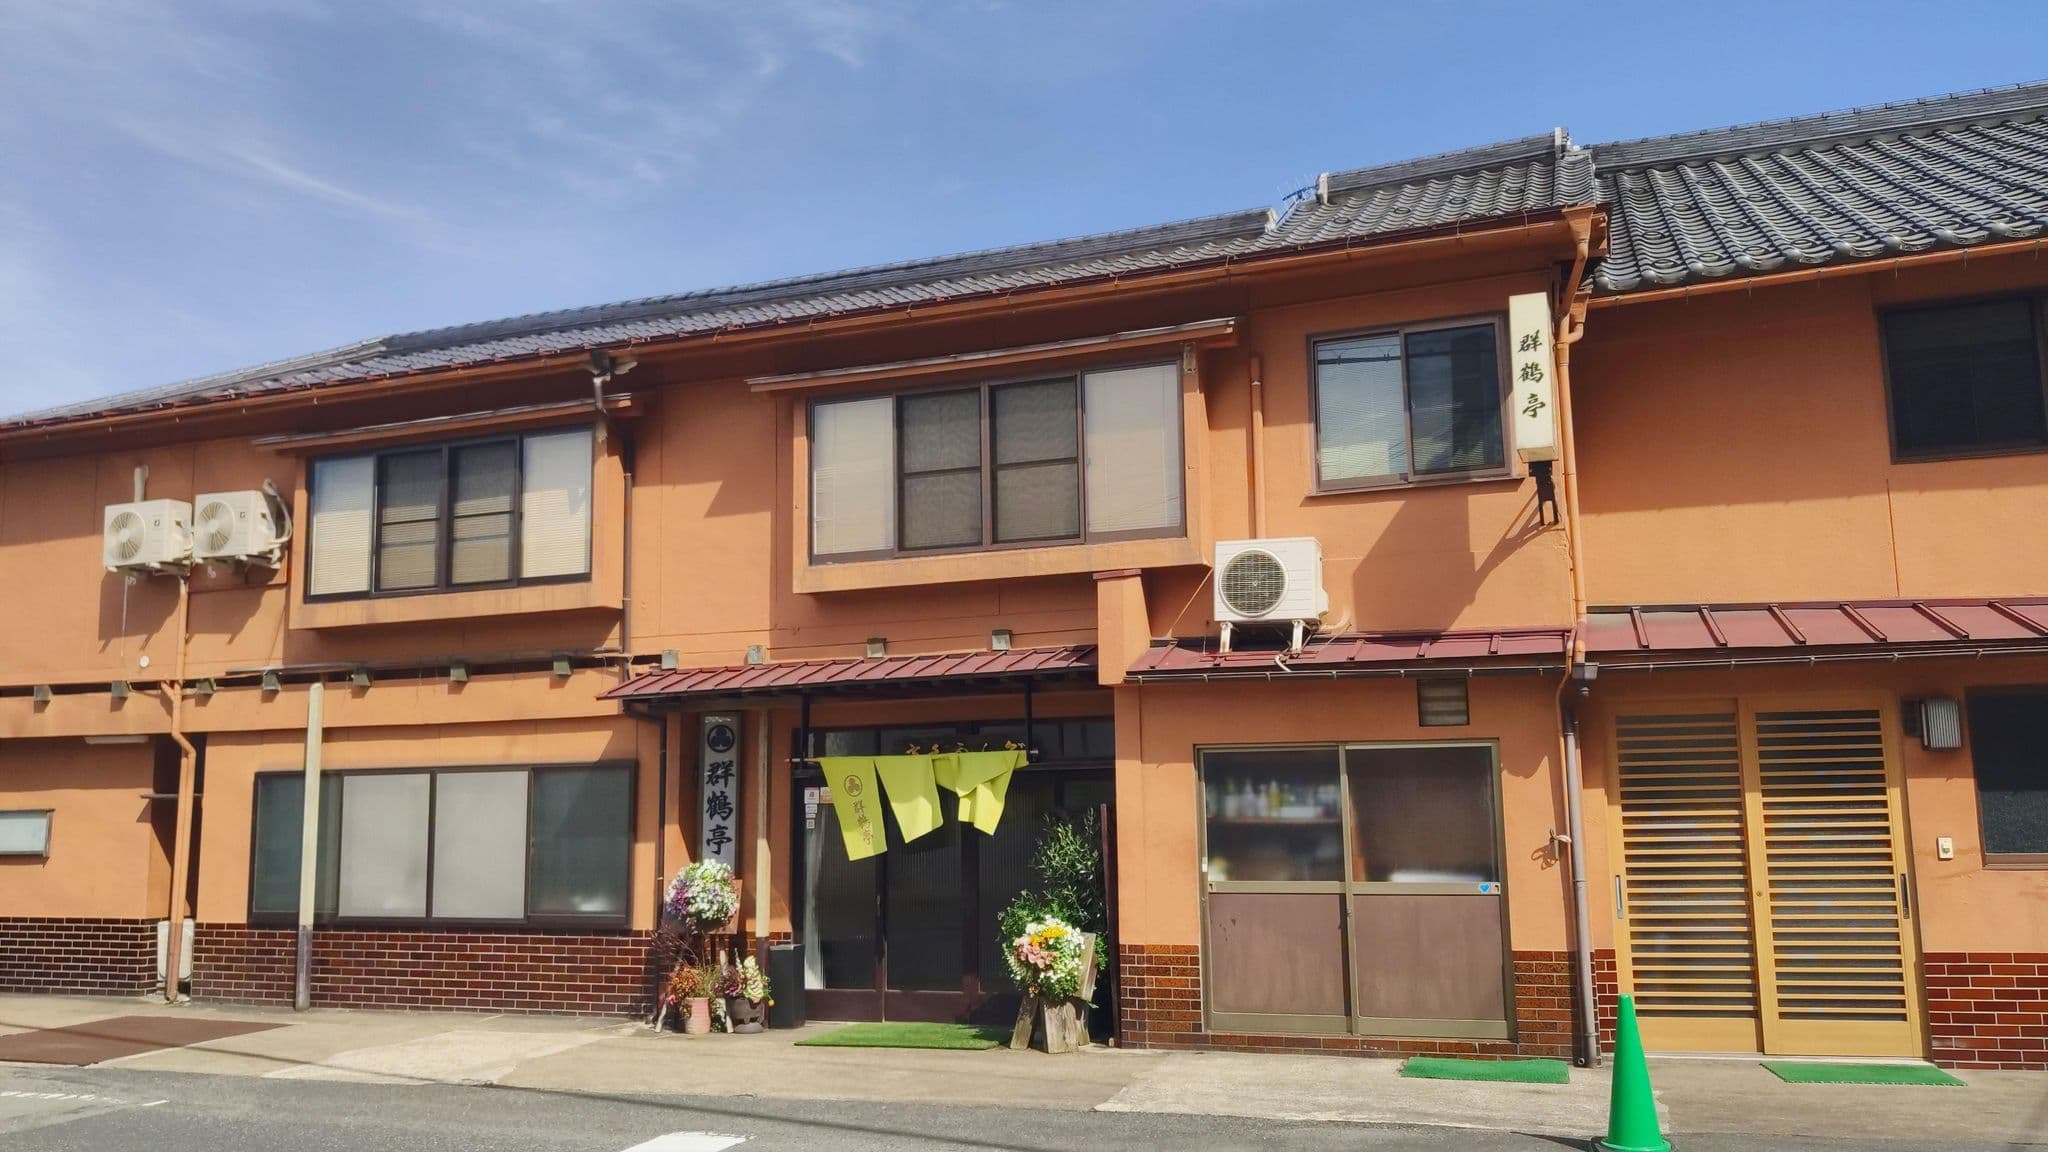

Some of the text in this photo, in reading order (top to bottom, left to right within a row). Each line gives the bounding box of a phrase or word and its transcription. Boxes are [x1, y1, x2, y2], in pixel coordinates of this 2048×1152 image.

[1518, 329, 1546, 419] 群鶴亭
[705, 759, 736, 855] 群鶴亭
